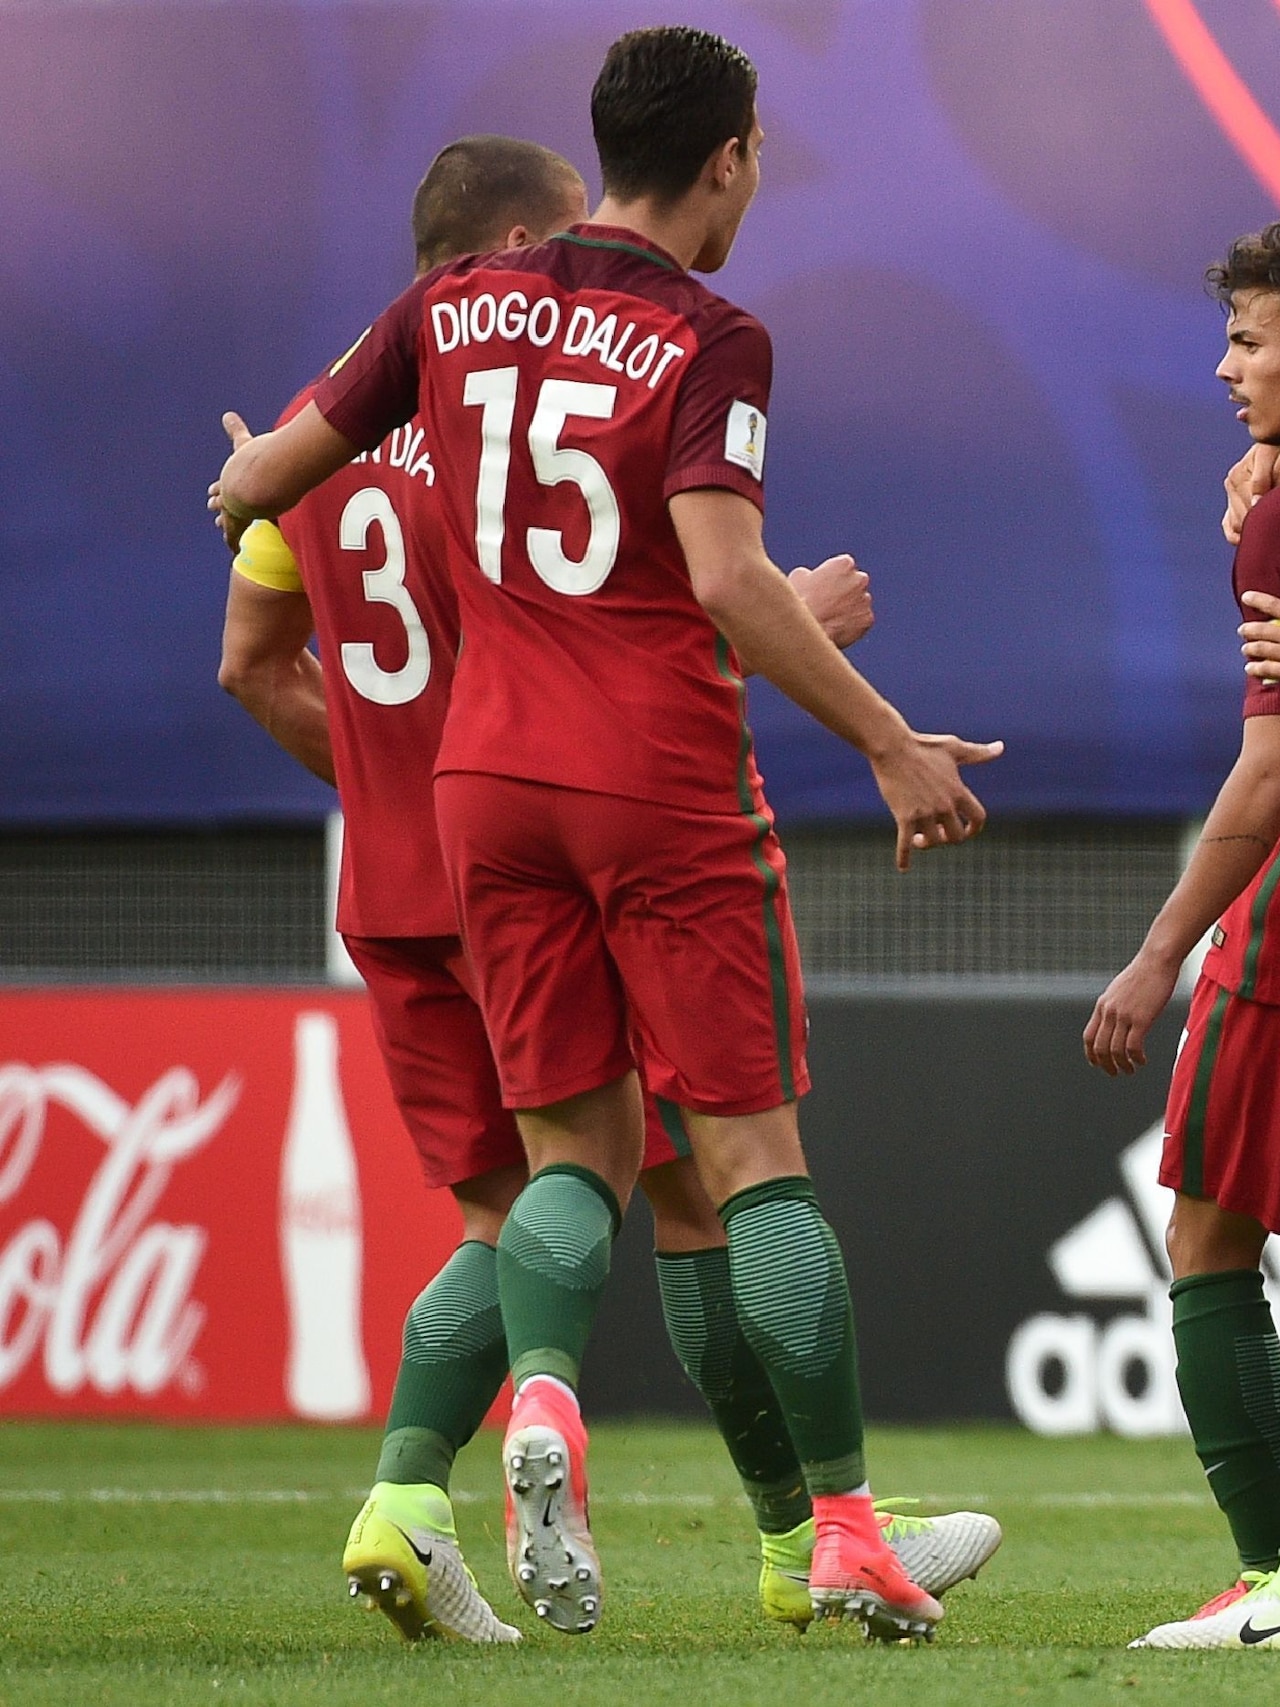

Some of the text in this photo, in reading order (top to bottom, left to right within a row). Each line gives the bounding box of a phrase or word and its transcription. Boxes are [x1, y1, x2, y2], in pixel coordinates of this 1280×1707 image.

[430, 290, 685, 389] DIOGO DALOT
[462, 366, 621, 596] 15
[340, 486, 431, 705] 3
